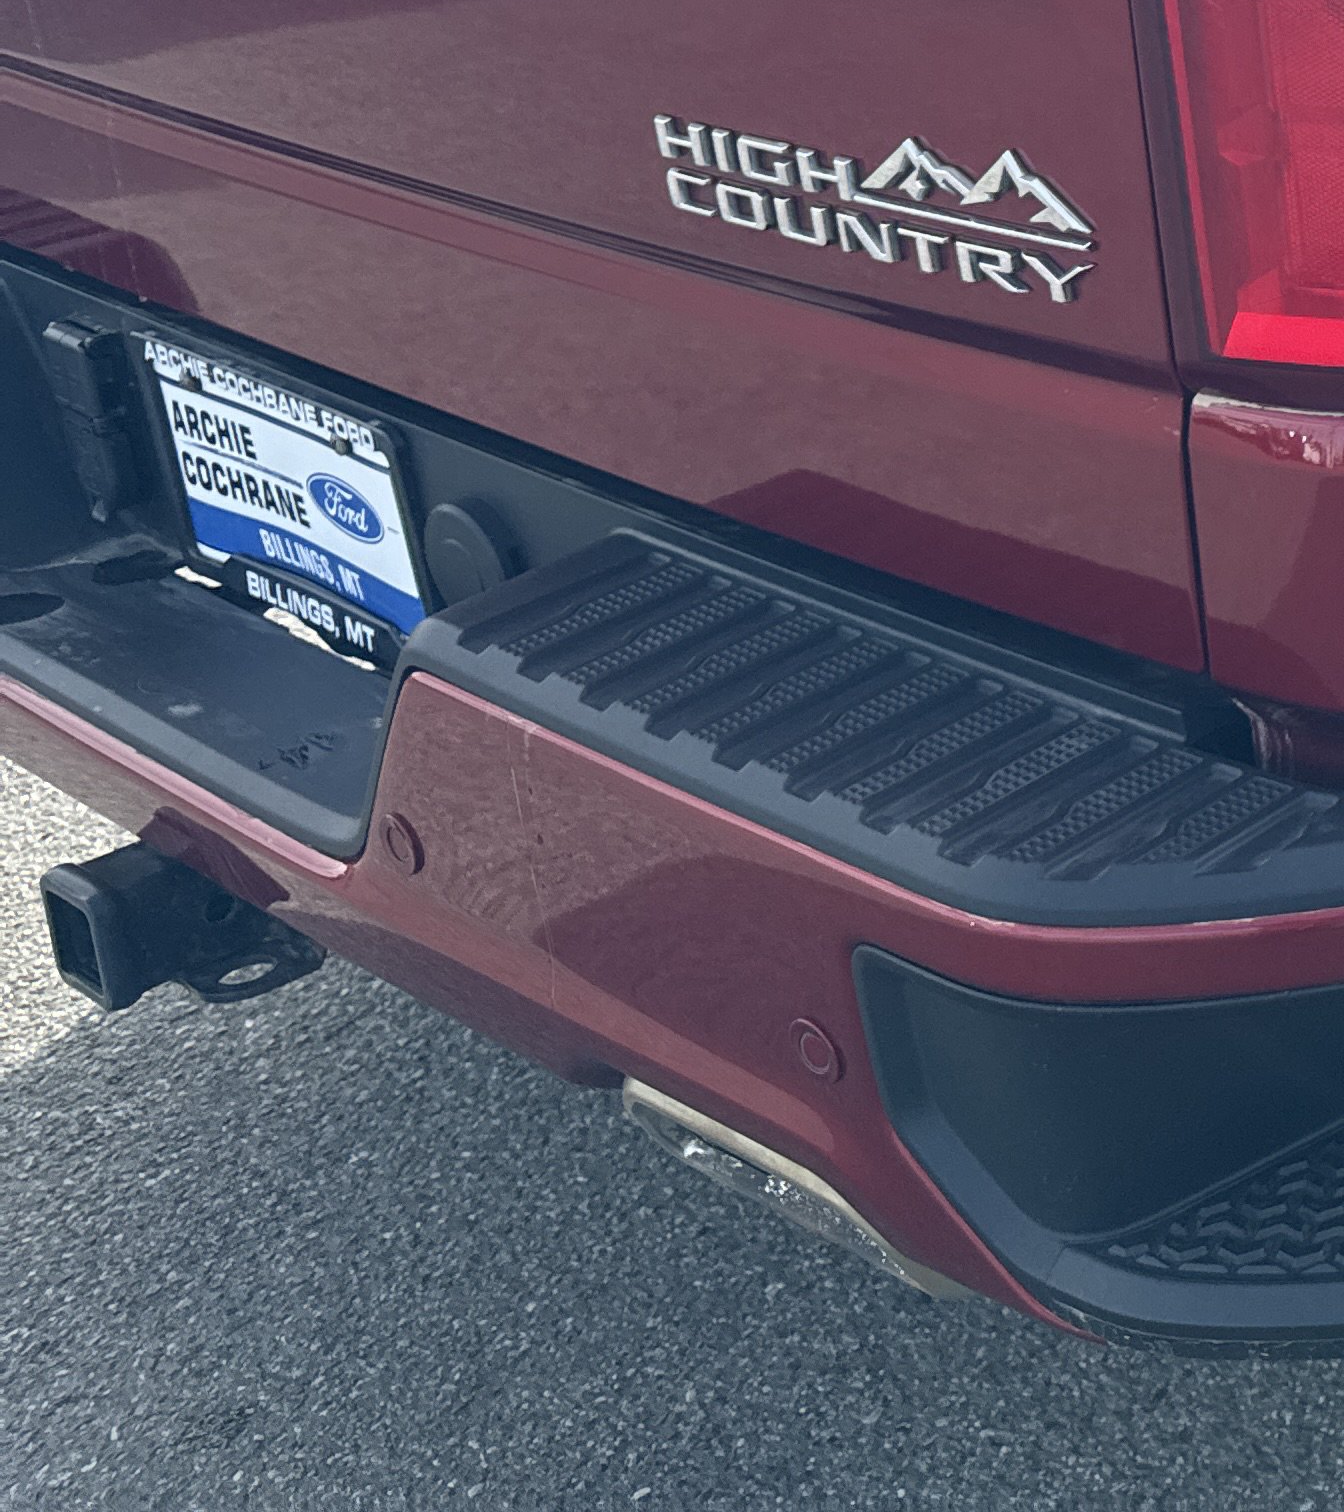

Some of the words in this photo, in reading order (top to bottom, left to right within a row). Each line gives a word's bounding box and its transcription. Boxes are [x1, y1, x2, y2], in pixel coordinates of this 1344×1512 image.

[654, 115, 859, 201] HIGH
[667, 168, 1096, 303] COUNTRY
[144, 340, 209, 381] ARCHIE
[171, 399, 257, 460] ARCHIE
[181, 450, 311, 528] COCHRANE
[323, 480, 369, 533] Ford
[245, 569, 341, 639] BILLINGS,
[345, 614, 375, 652] MT
[337, 564, 365, 601] MT
